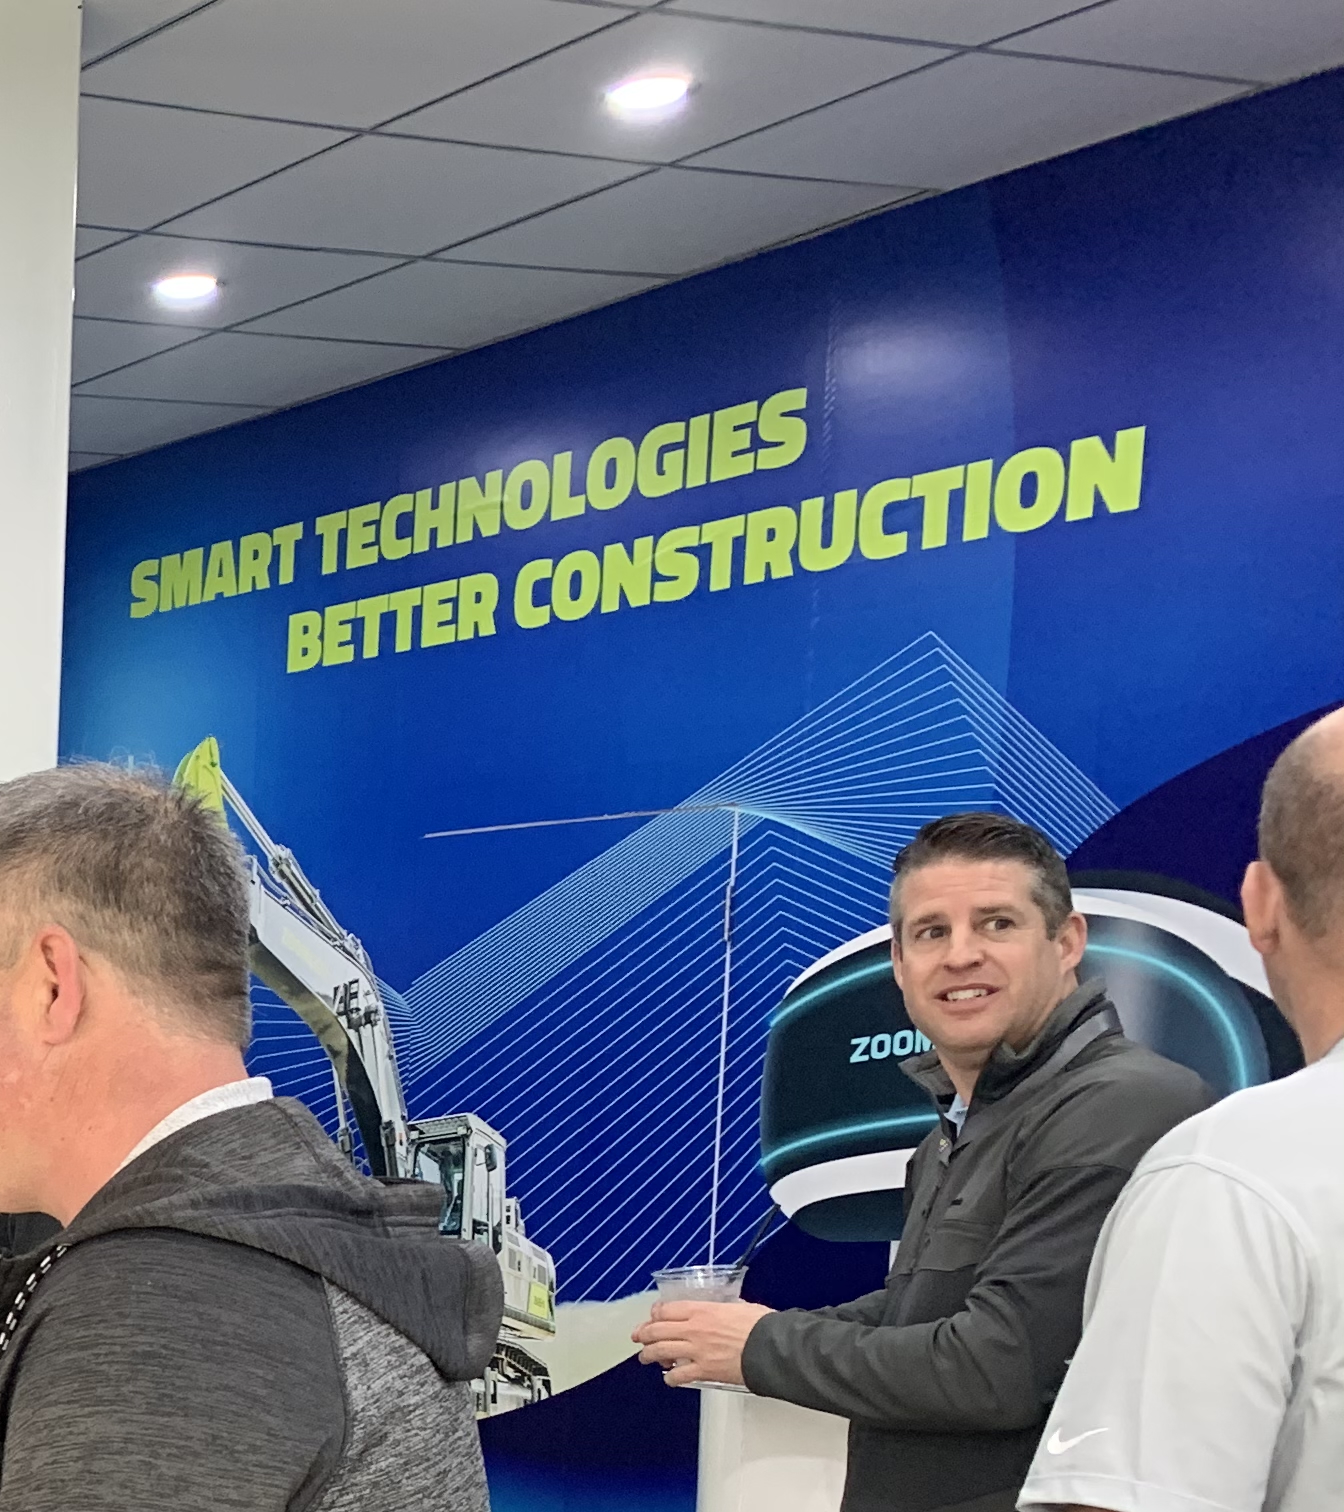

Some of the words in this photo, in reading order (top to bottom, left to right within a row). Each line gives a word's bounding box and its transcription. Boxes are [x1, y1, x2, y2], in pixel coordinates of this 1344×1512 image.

[131, 522, 303, 619] SMART
[315, 387, 808, 575] TECHNOLOGIES
[286, 572, 500, 673] BETTER
[513, 425, 1147, 629] CONSTRUCTION
